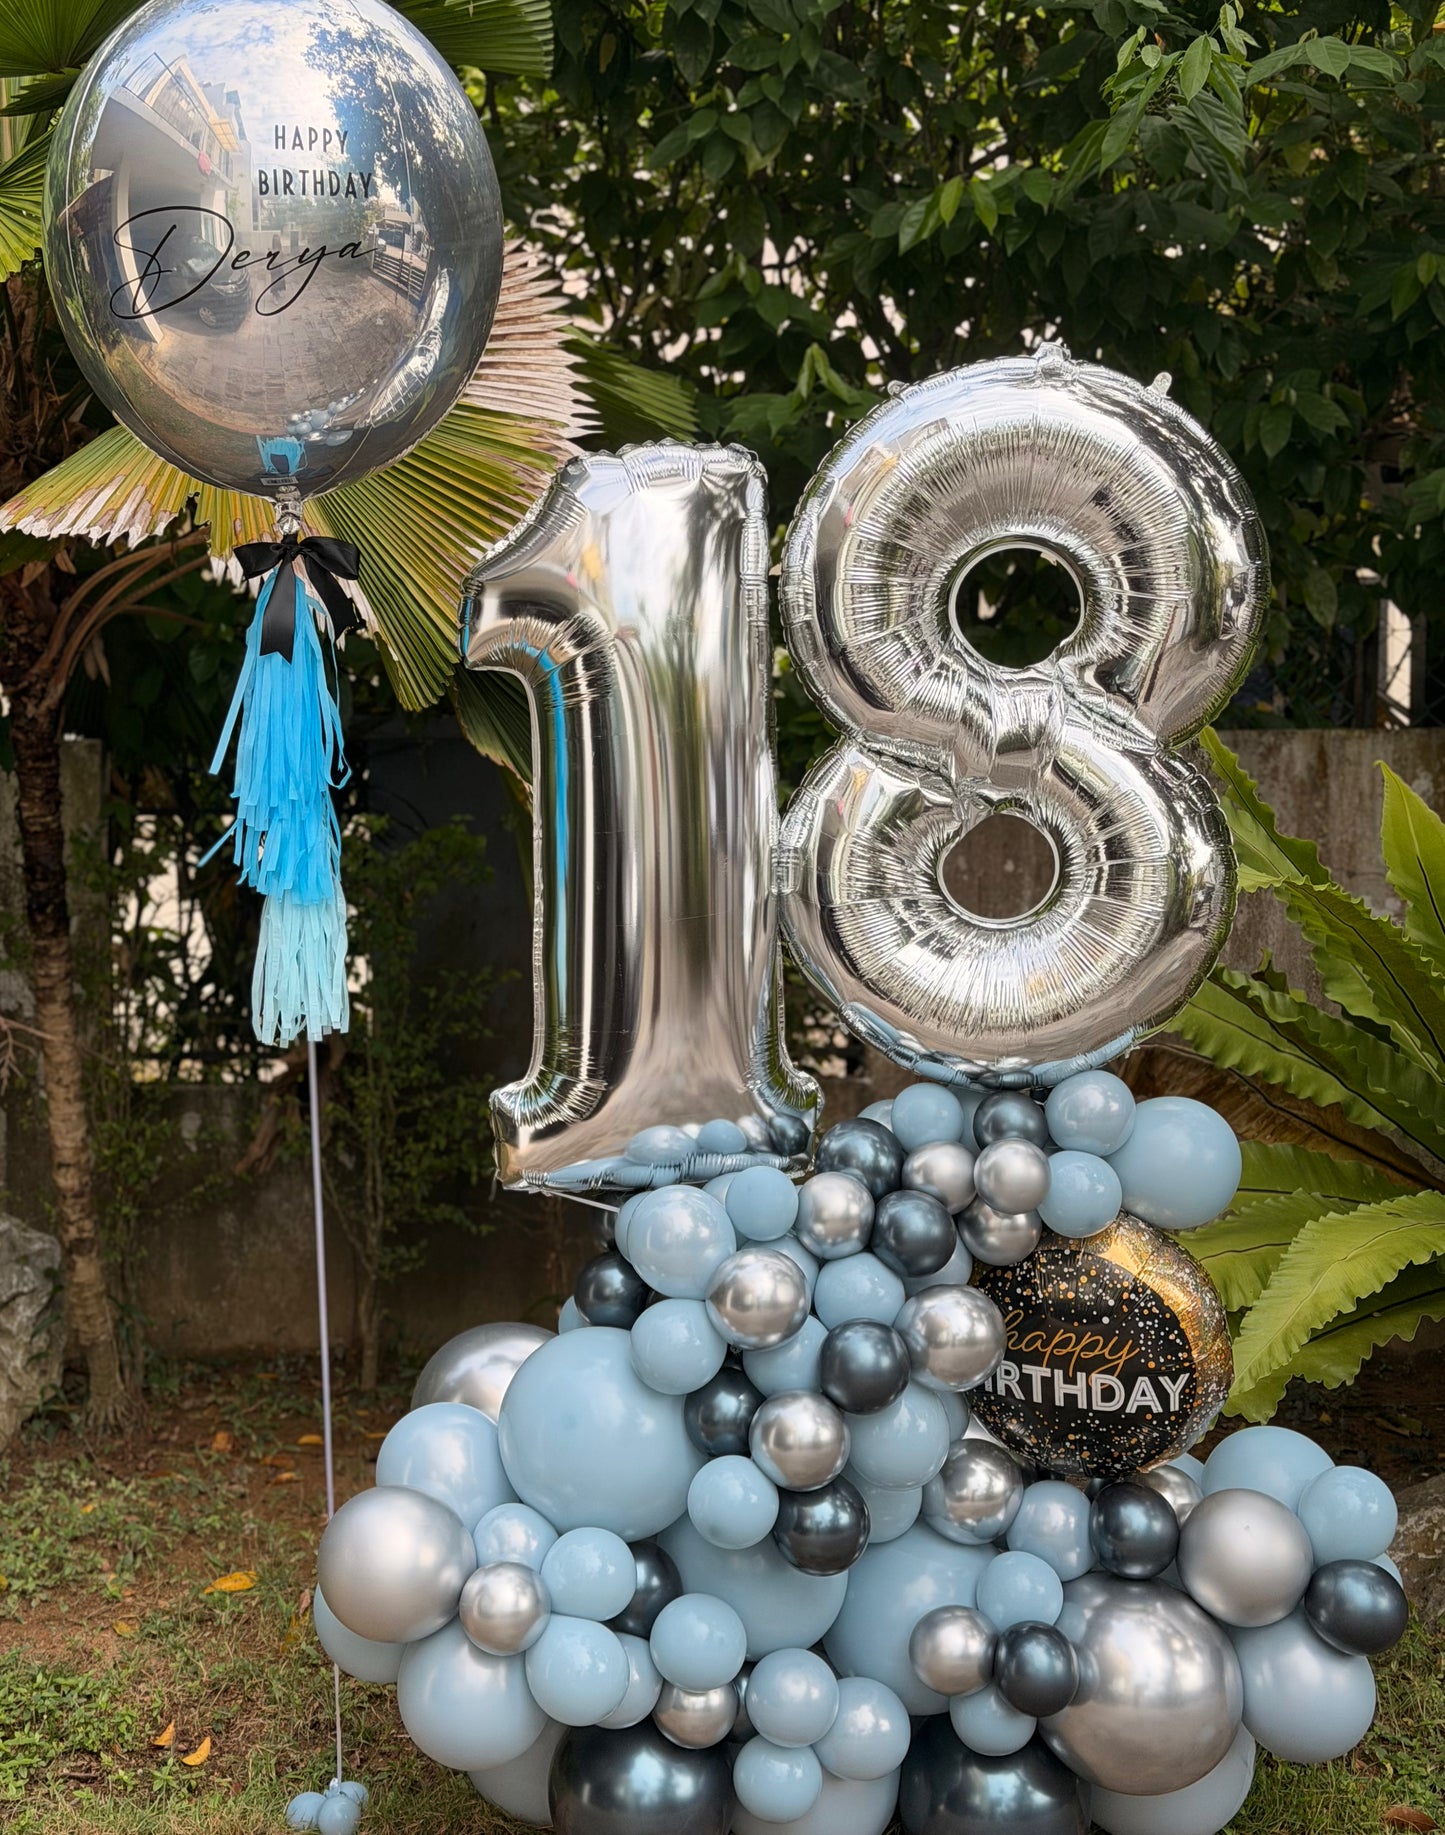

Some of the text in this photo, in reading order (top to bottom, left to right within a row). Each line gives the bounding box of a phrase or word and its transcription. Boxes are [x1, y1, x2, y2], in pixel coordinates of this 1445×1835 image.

[274, 125, 348, 154] HAPPY
[258, 169, 373, 198] BIRTHDAY
[110, 205, 378, 320] Derya
[984, 1360, 1190, 1413] RTHDAY
